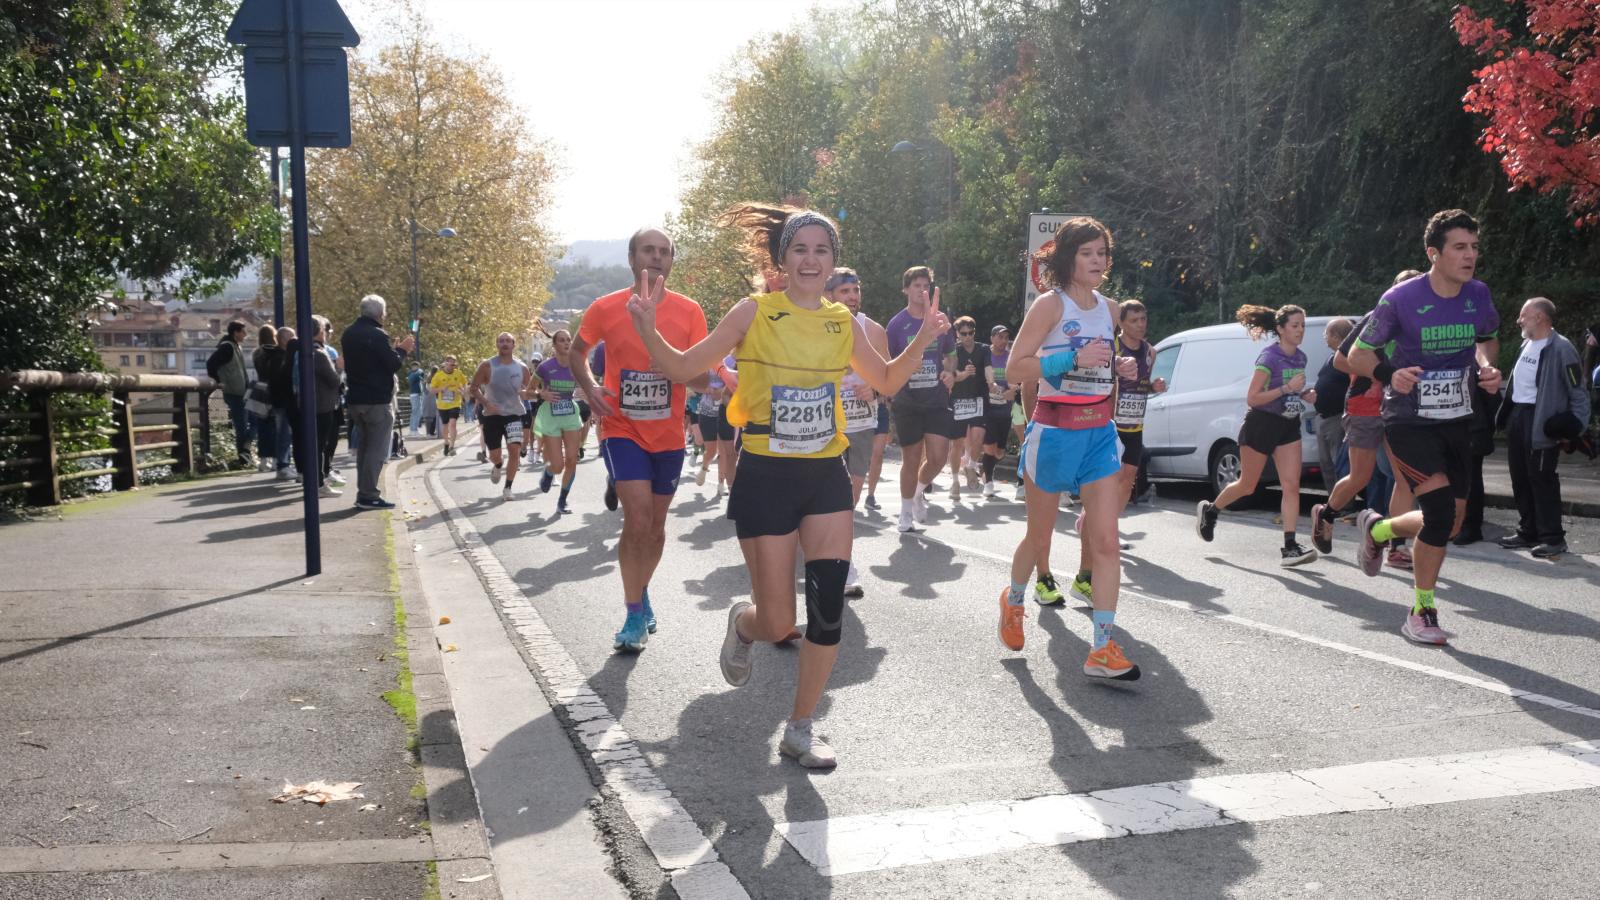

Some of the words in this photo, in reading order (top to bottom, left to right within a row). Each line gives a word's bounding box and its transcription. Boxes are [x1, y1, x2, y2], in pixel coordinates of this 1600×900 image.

[1421, 323, 1476, 341] BEHOBIA
[624, 383, 668, 398] 24175
[777, 401, 831, 423] 22816
[797, 426, 818, 434] JULIA
